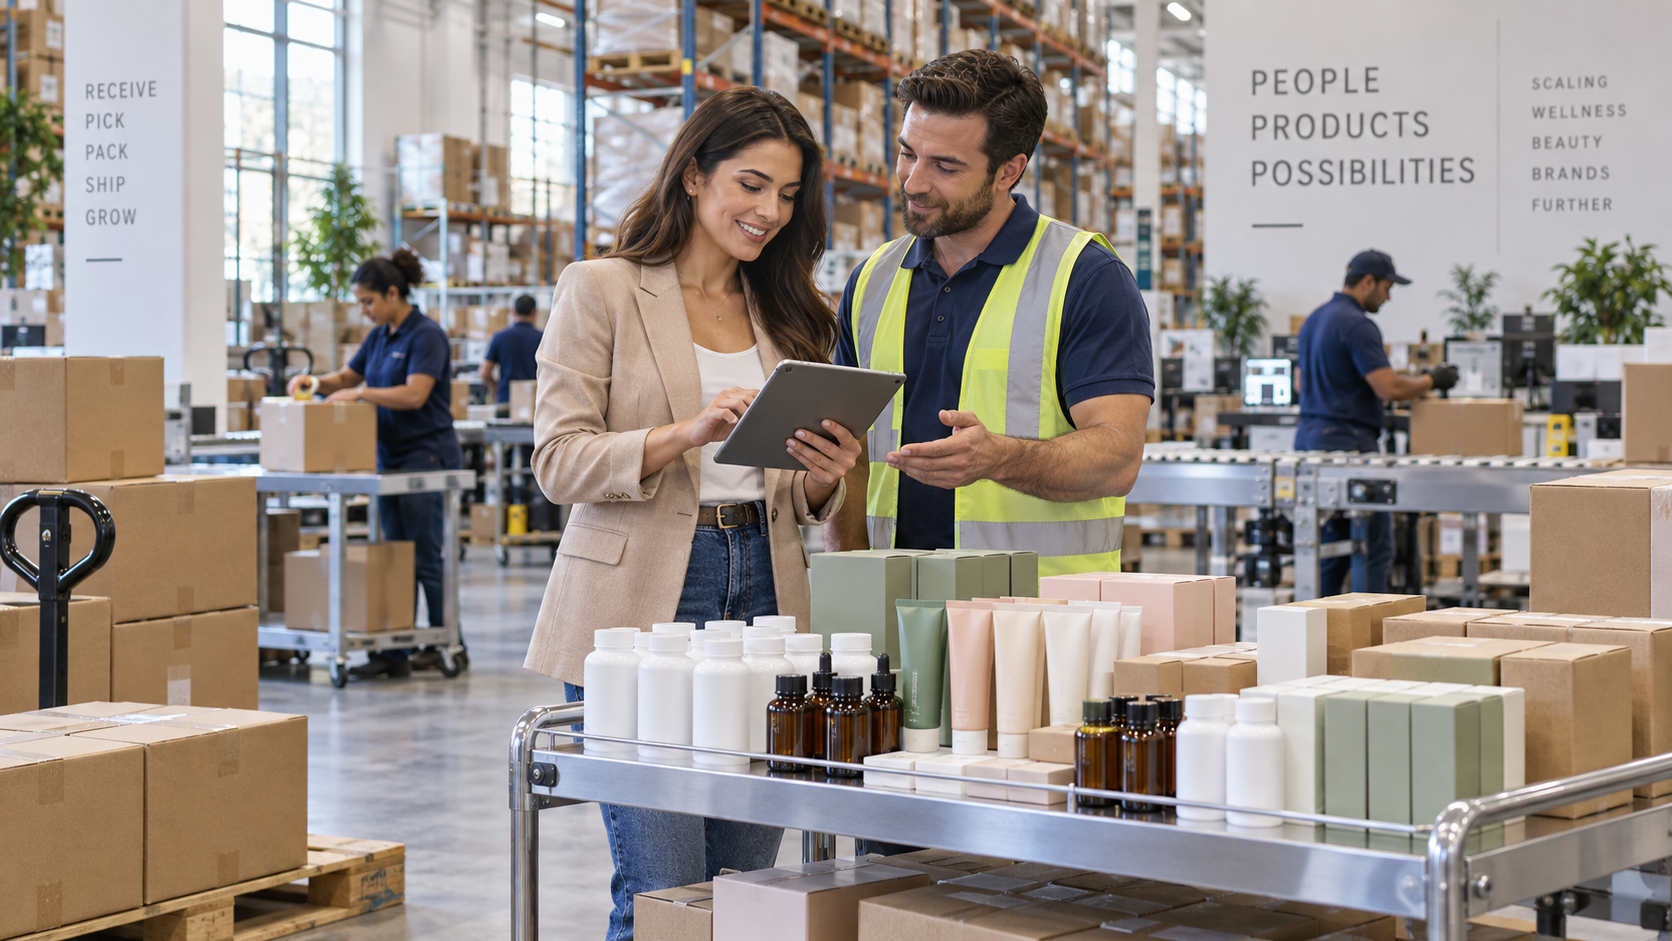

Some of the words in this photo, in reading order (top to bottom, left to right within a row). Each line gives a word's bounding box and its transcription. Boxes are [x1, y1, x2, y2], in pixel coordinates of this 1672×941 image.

[1252, 66, 1379, 96] PEOPLE
[1532, 75, 1608, 90] SCALING
[85, 80, 157, 100] RECEIVE
[1532, 104, 1627, 119] WELLNESS
[85, 112, 125, 129] PICK
[1252, 110, 1429, 141] PRODUCTS
[1532, 135, 1602, 150] BEAUTY
[85, 143, 128, 160] PACK
[1252, 156, 1475, 187] POSSIBILITIES
[1532, 166, 1610, 181] BRANDS
[85, 176, 125, 193] SHIP
[1532, 197, 1612, 212] FURTHER
[85, 208, 137, 226] GROW
